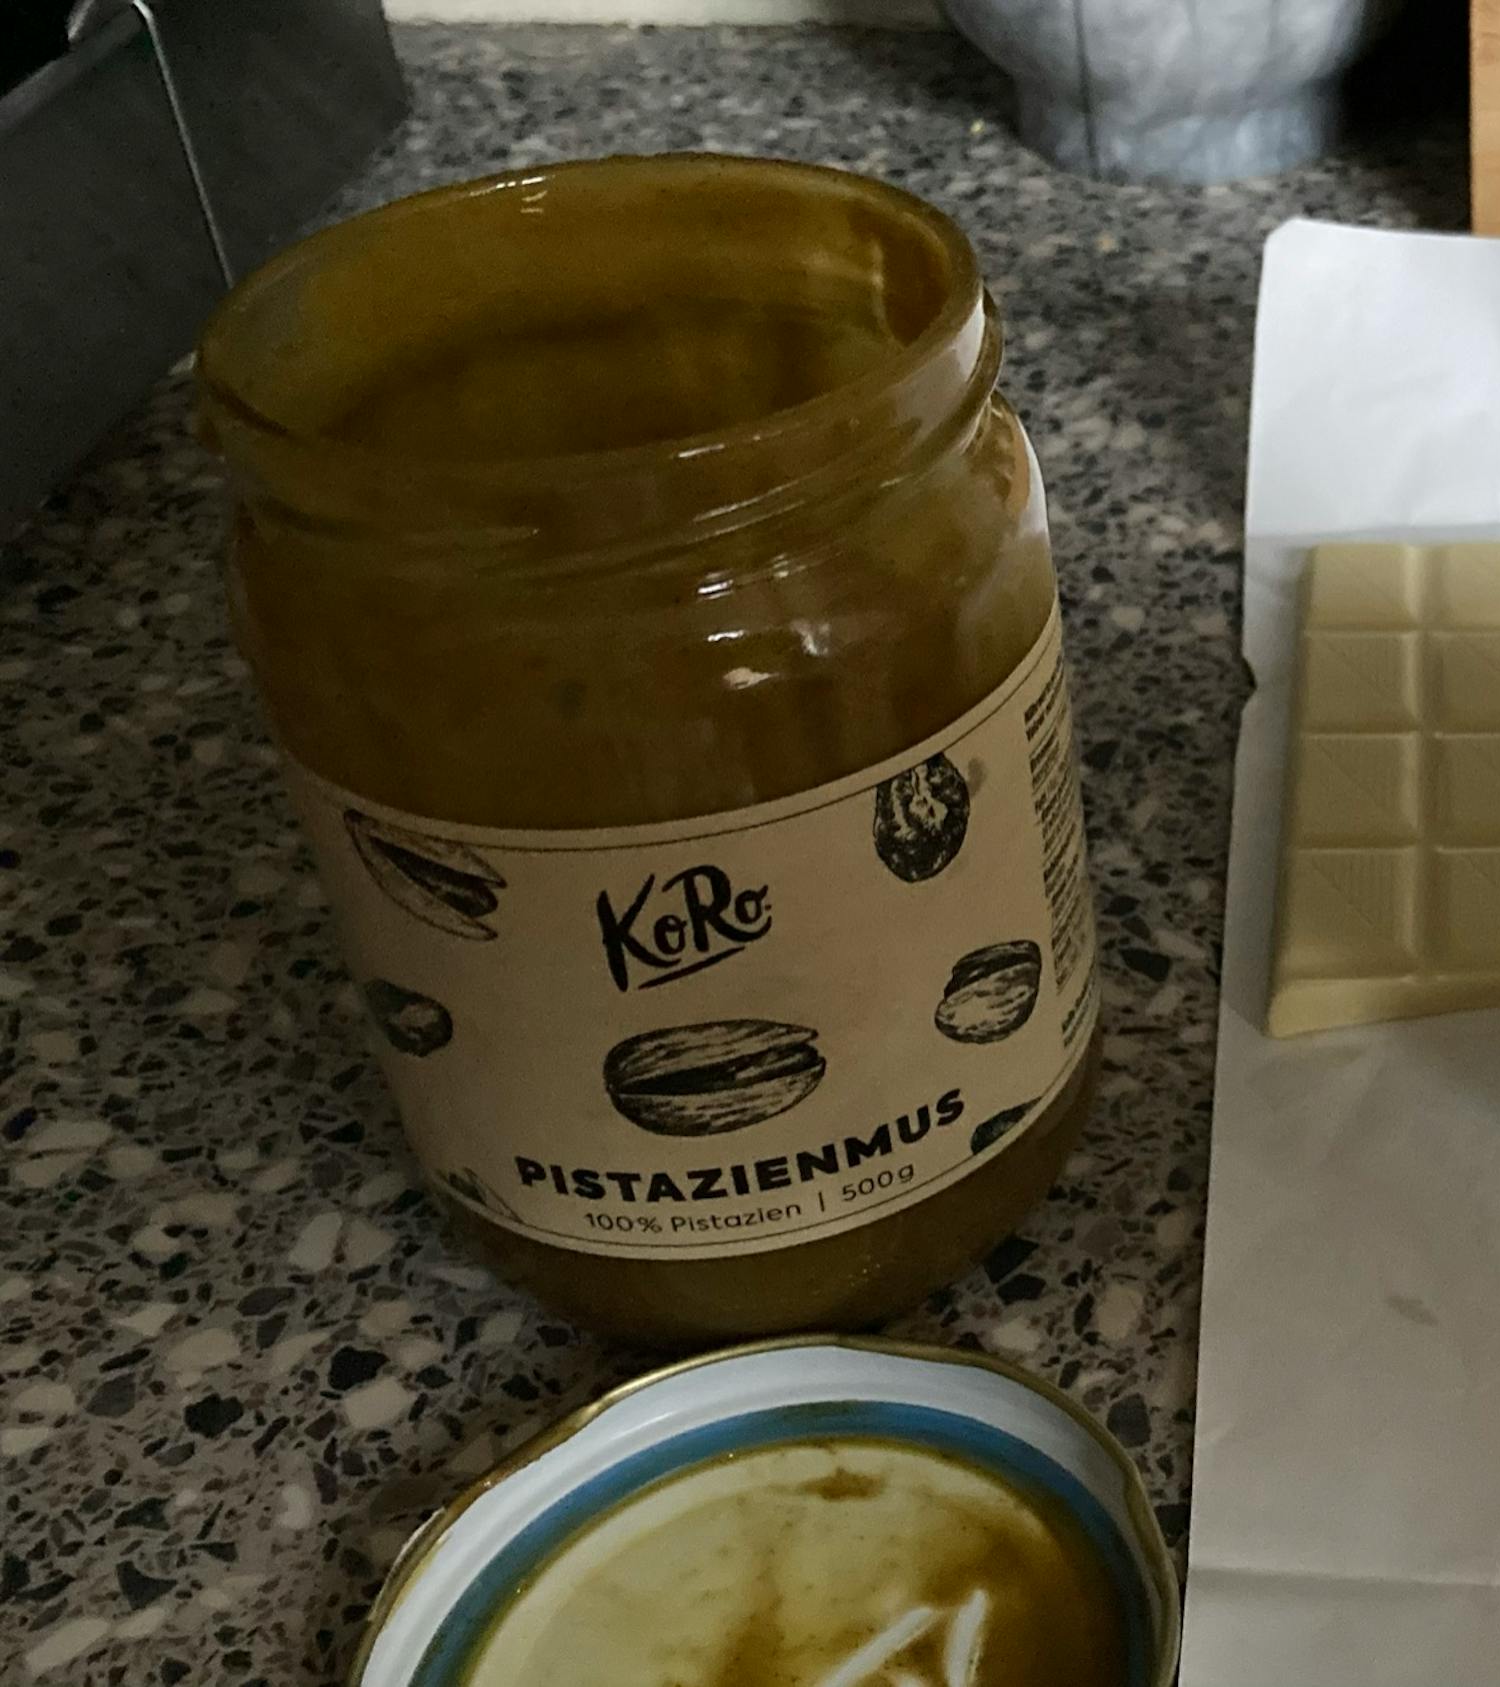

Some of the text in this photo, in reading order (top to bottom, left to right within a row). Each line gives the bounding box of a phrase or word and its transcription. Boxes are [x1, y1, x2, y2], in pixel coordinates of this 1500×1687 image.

[597, 865, 772, 992] KoRo
[514, 1087, 966, 1203] PISTAZIENMUS
[584, 1211, 662, 1234] 100%
[671, 1201, 802, 1233] Pistazien
[841, 1163, 916, 1203] 500g
